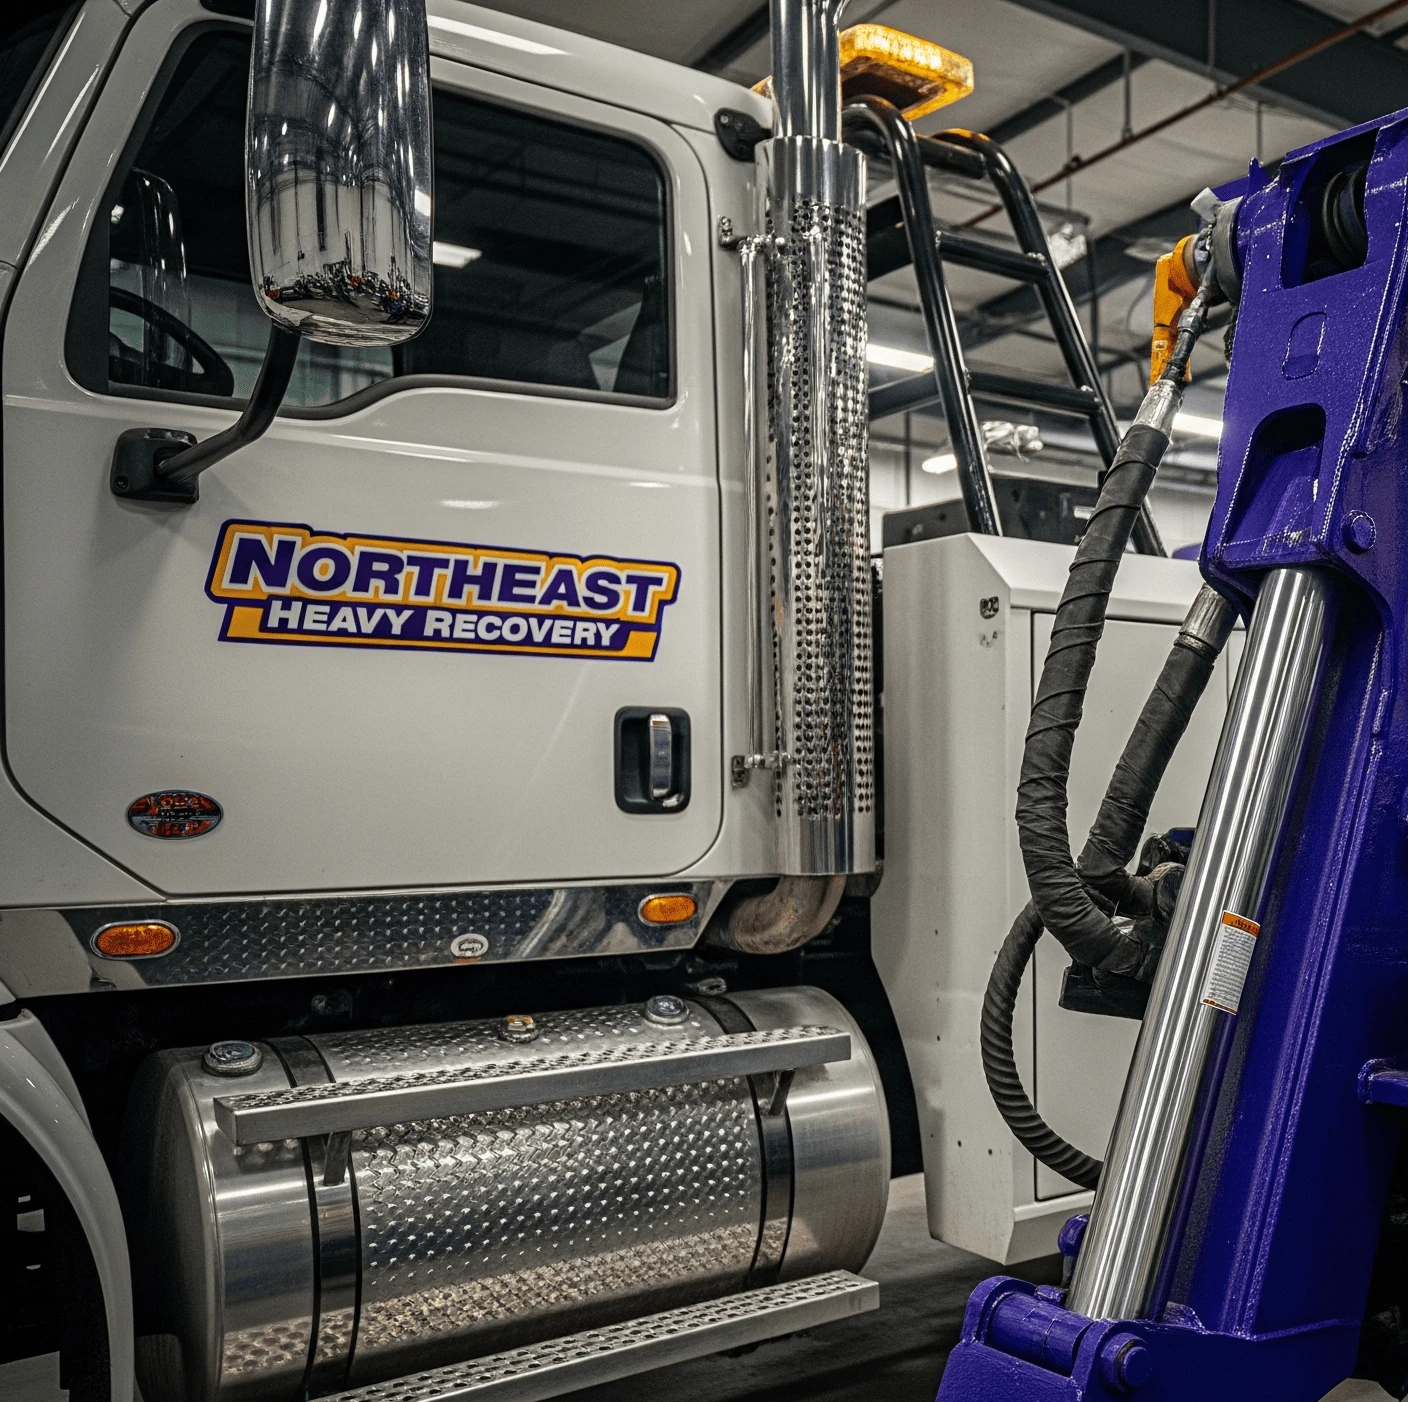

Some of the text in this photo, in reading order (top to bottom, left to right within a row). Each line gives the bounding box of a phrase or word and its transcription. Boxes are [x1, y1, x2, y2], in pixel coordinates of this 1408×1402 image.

[225, 533, 668, 616] NORTHEAST
[266, 600, 621, 647] HEAVY RECOVERY
